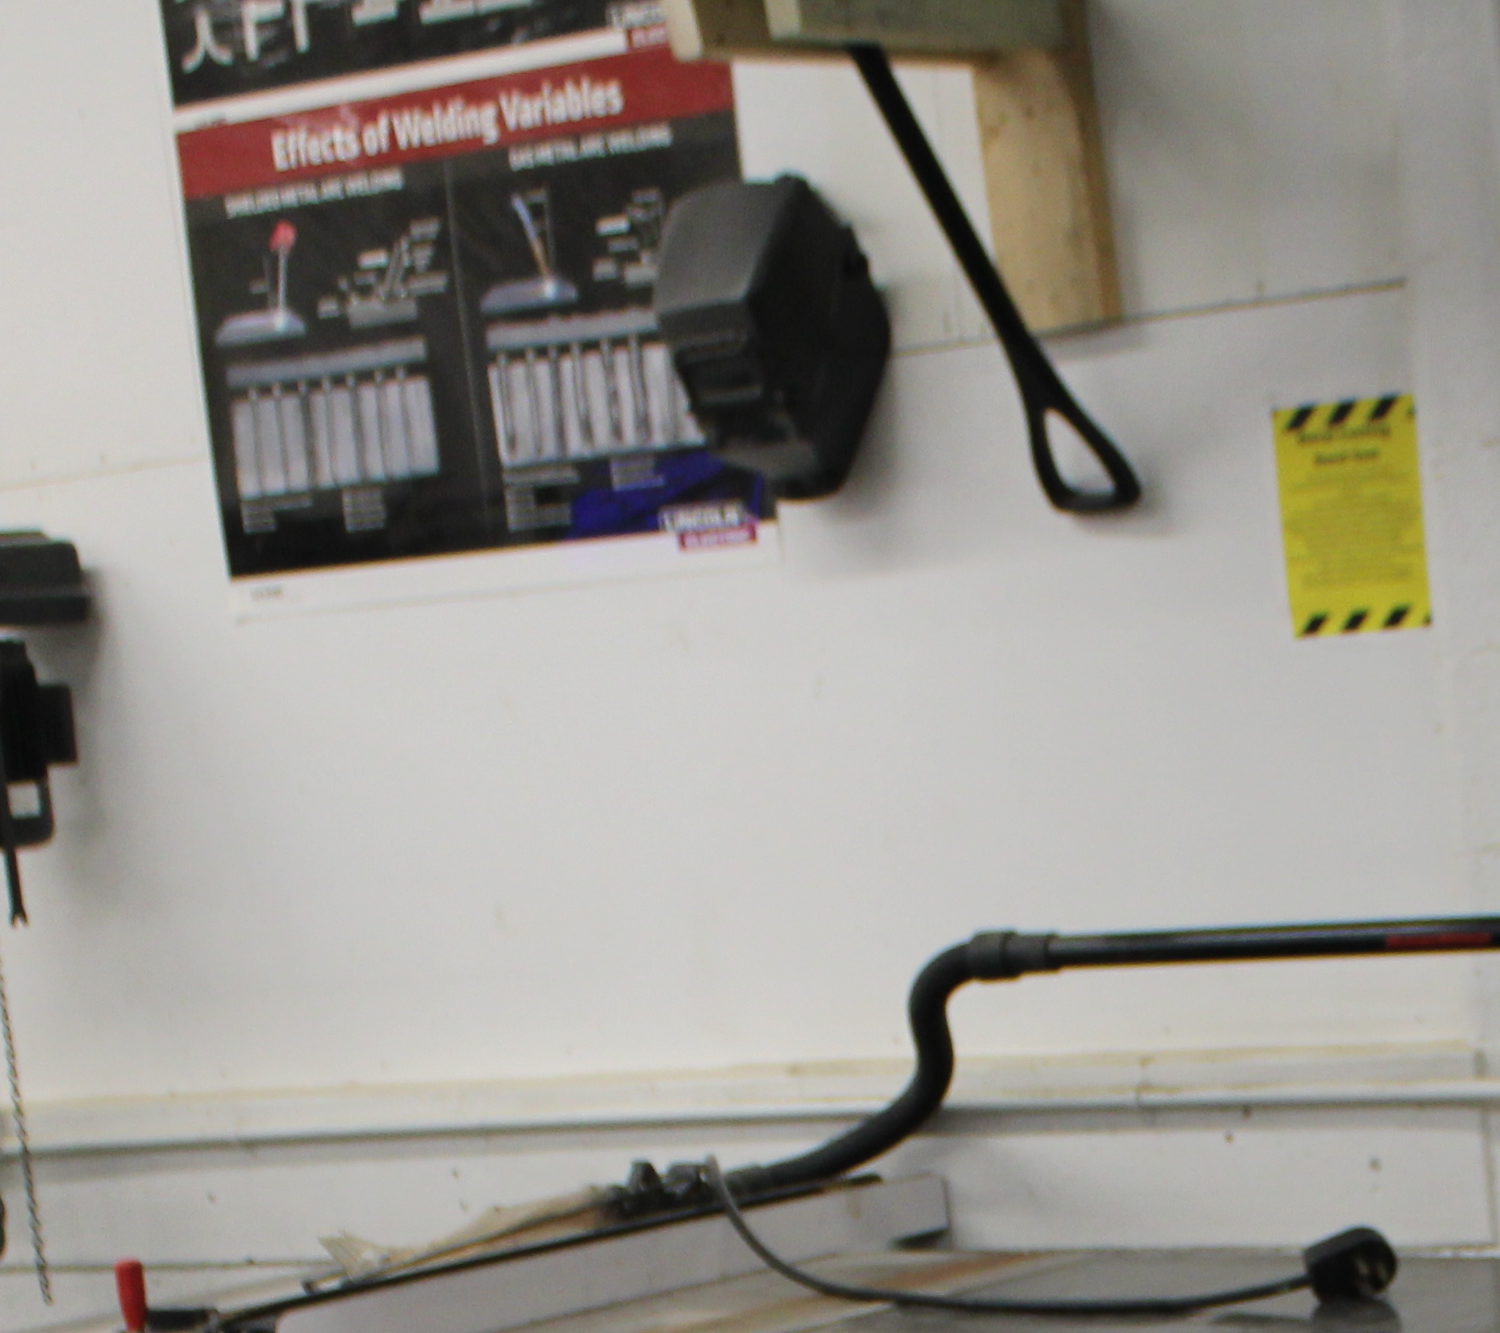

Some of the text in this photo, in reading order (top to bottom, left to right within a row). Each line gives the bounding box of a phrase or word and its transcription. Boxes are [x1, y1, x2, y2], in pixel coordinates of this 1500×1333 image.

[271, 79, 623, 171] Effects of Welding Variables
